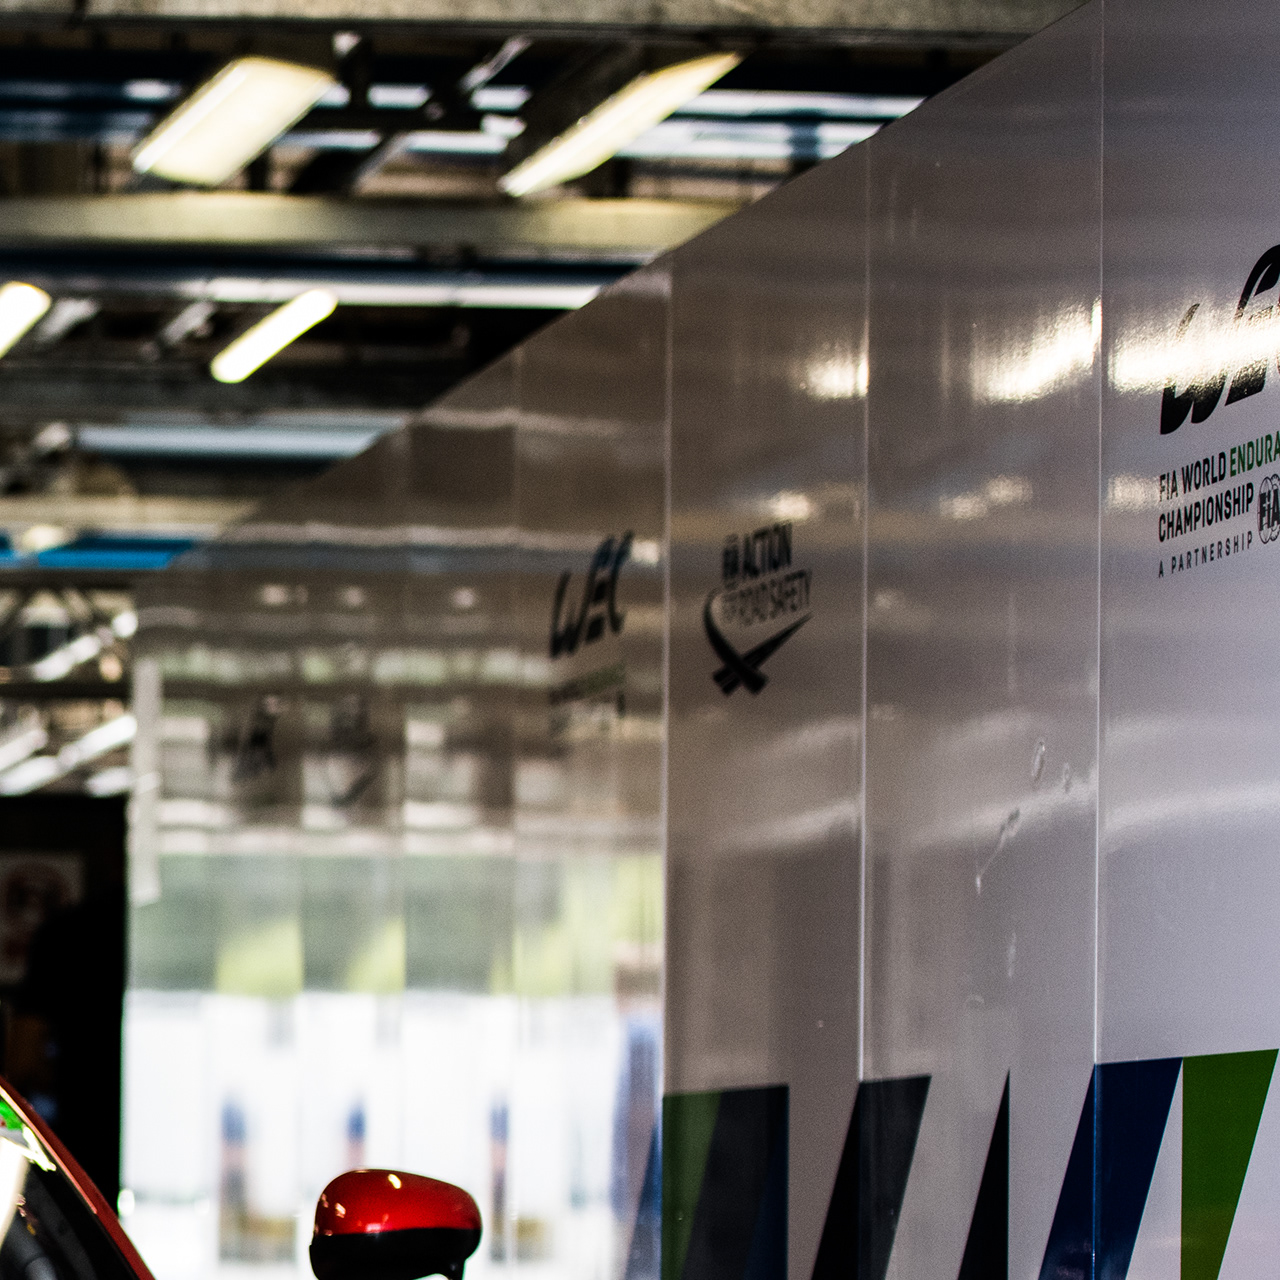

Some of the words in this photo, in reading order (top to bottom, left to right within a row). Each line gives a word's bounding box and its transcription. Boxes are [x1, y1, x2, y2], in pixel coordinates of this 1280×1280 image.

[1159, 470, 1178, 502] FIA
[1182, 451, 1227, 495] WORLD
[1158, 482, 1254, 542] CHAMPIONSHIP
[1158, 559, 1165, 579] A
[1171, 530, 1253, 574] PARTNERSHIP
